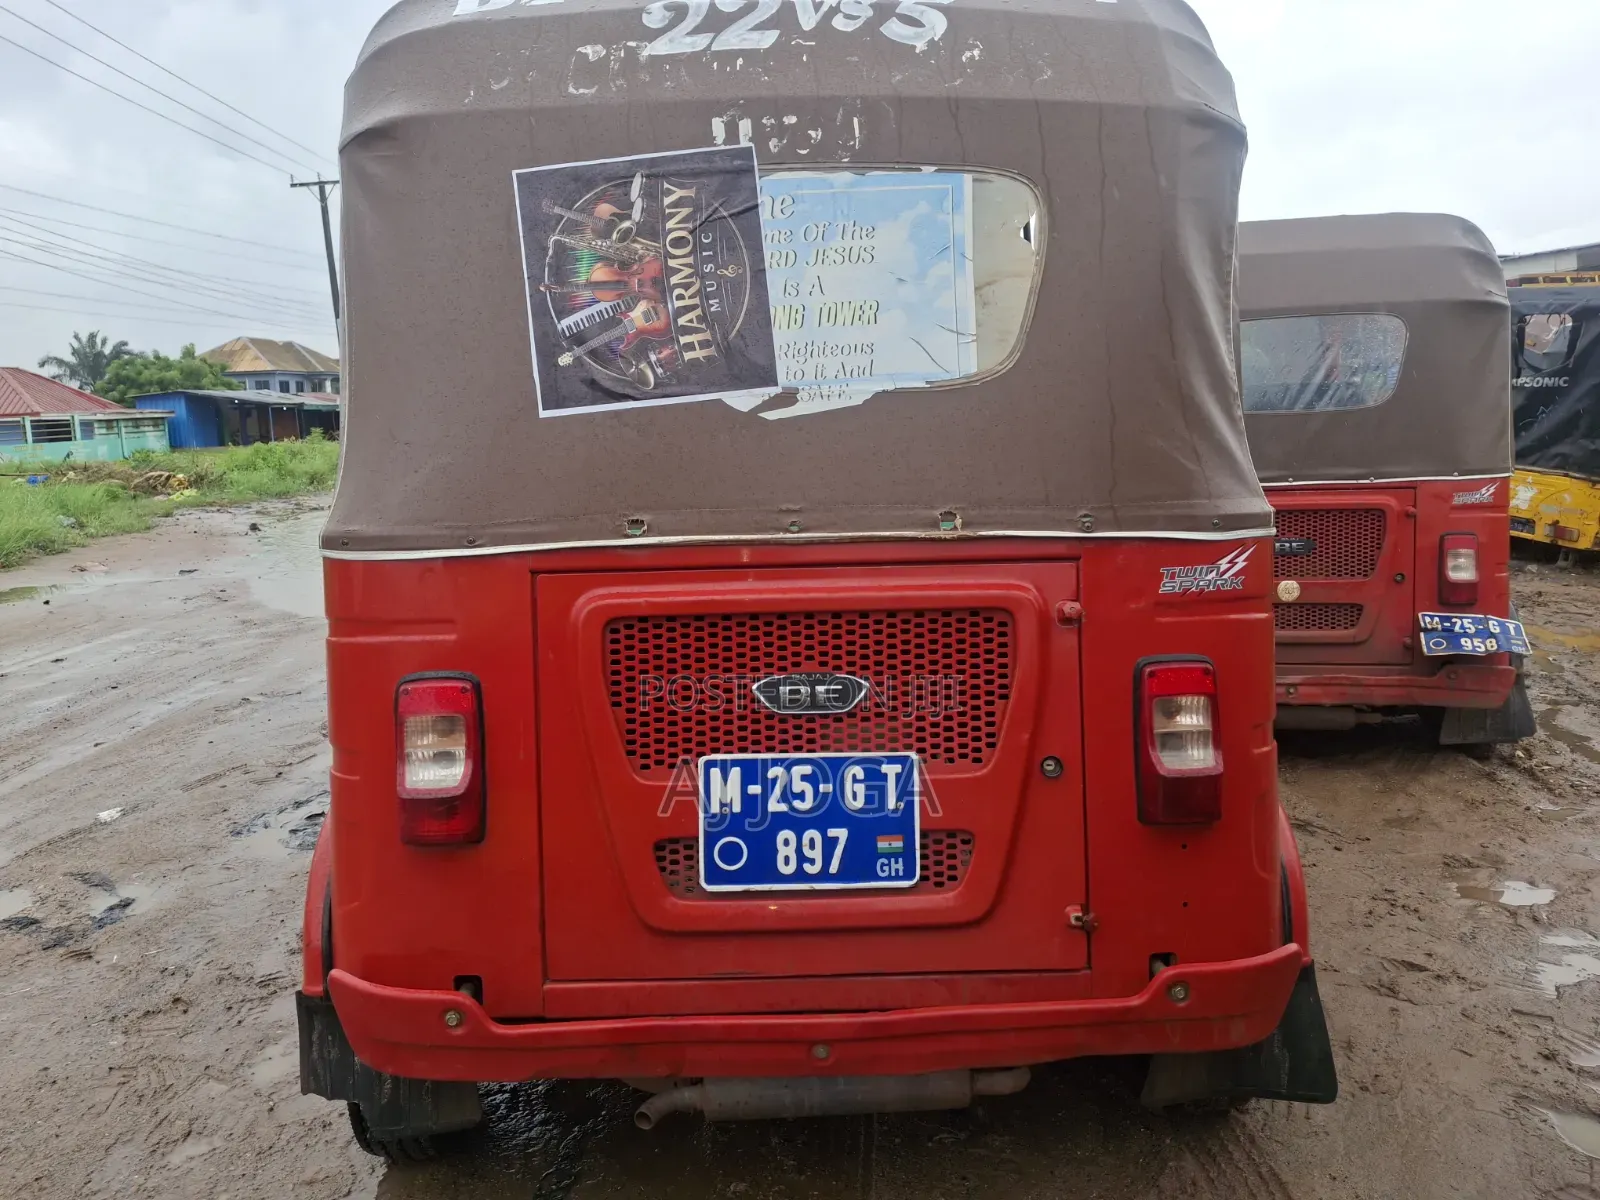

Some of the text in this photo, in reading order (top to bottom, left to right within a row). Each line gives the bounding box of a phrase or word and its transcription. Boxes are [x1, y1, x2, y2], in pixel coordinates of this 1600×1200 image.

[803, 221, 832, 243] Of
[835, 219, 876, 242] The
[805, 245, 876, 268] JESUS
[664, 181, 719, 363] HARMONY
[702, 232, 722, 313] MUSIC
[809, 274, 826, 297] A
[817, 299, 879, 329] TOWER
[778, 340, 875, 365] Righteous
[786, 365, 805, 383] to
[834, 359, 874, 380] And
[1160, 565, 1221, 580] TWIN
[1159, 576, 1246, 594] SPARK
[1460, 637, 1498, 652] 958
[792, 673, 831, 681] BAJAJ
[776, 828, 849, 876] 897
[876, 857, 904, 877] GH
